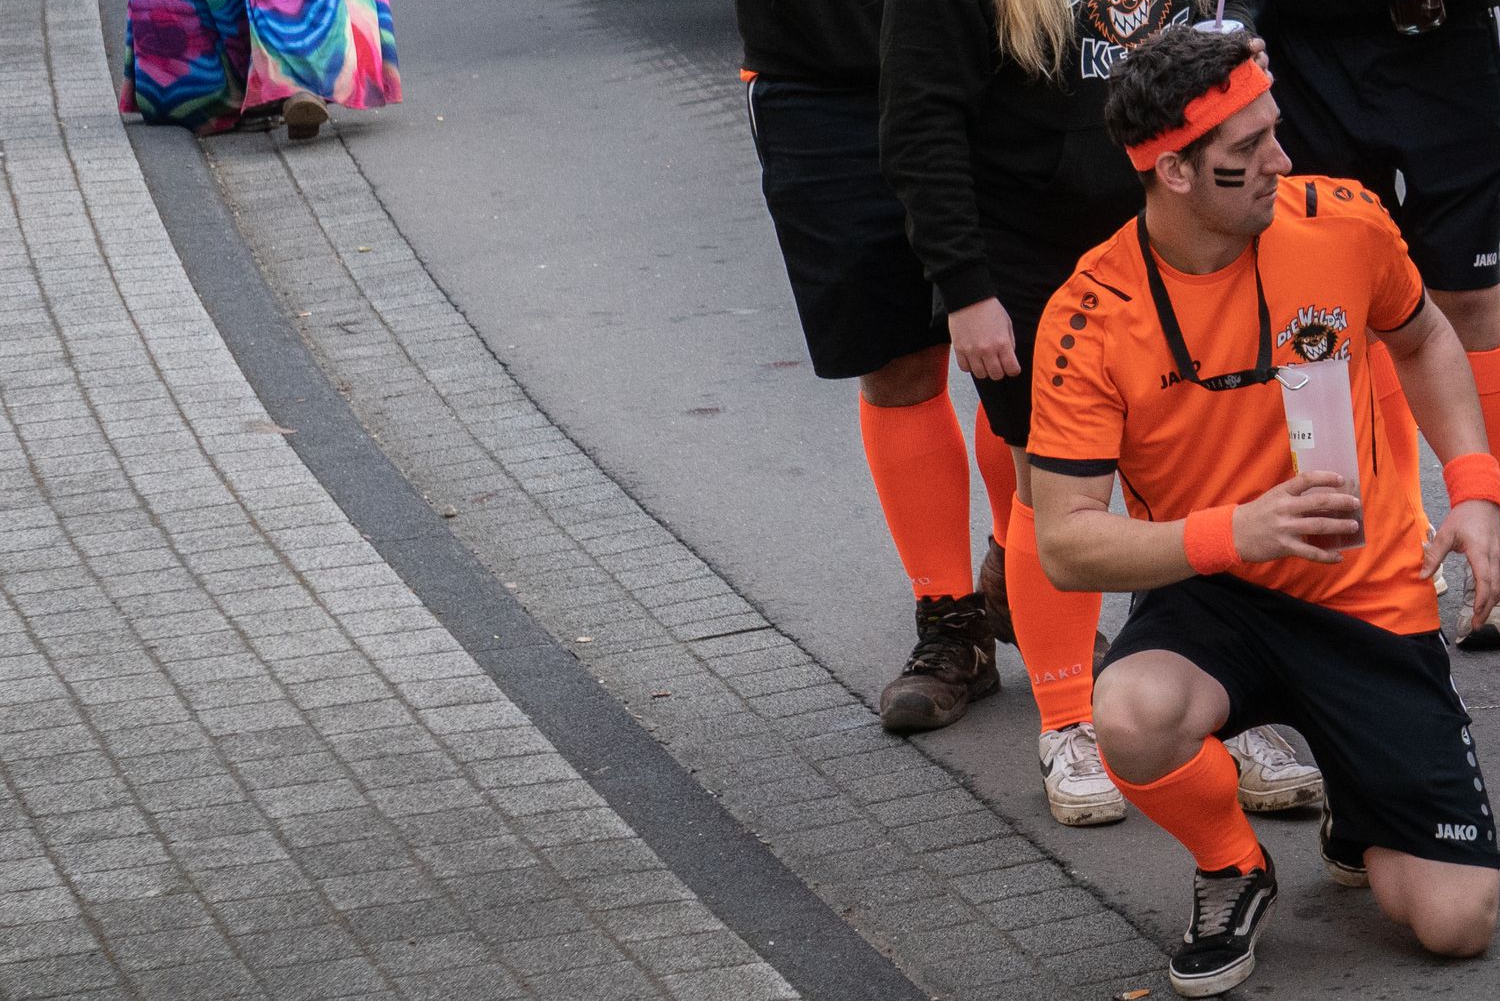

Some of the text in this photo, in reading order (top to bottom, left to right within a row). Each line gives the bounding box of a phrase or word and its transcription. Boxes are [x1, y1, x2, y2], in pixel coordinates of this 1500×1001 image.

[1473, 252, 1498, 267] JAKO
[1161, 360, 1201, 389] JAO
[1034, 663, 1082, 685] JAKO
[1435, 823, 1478, 841] JAKO
